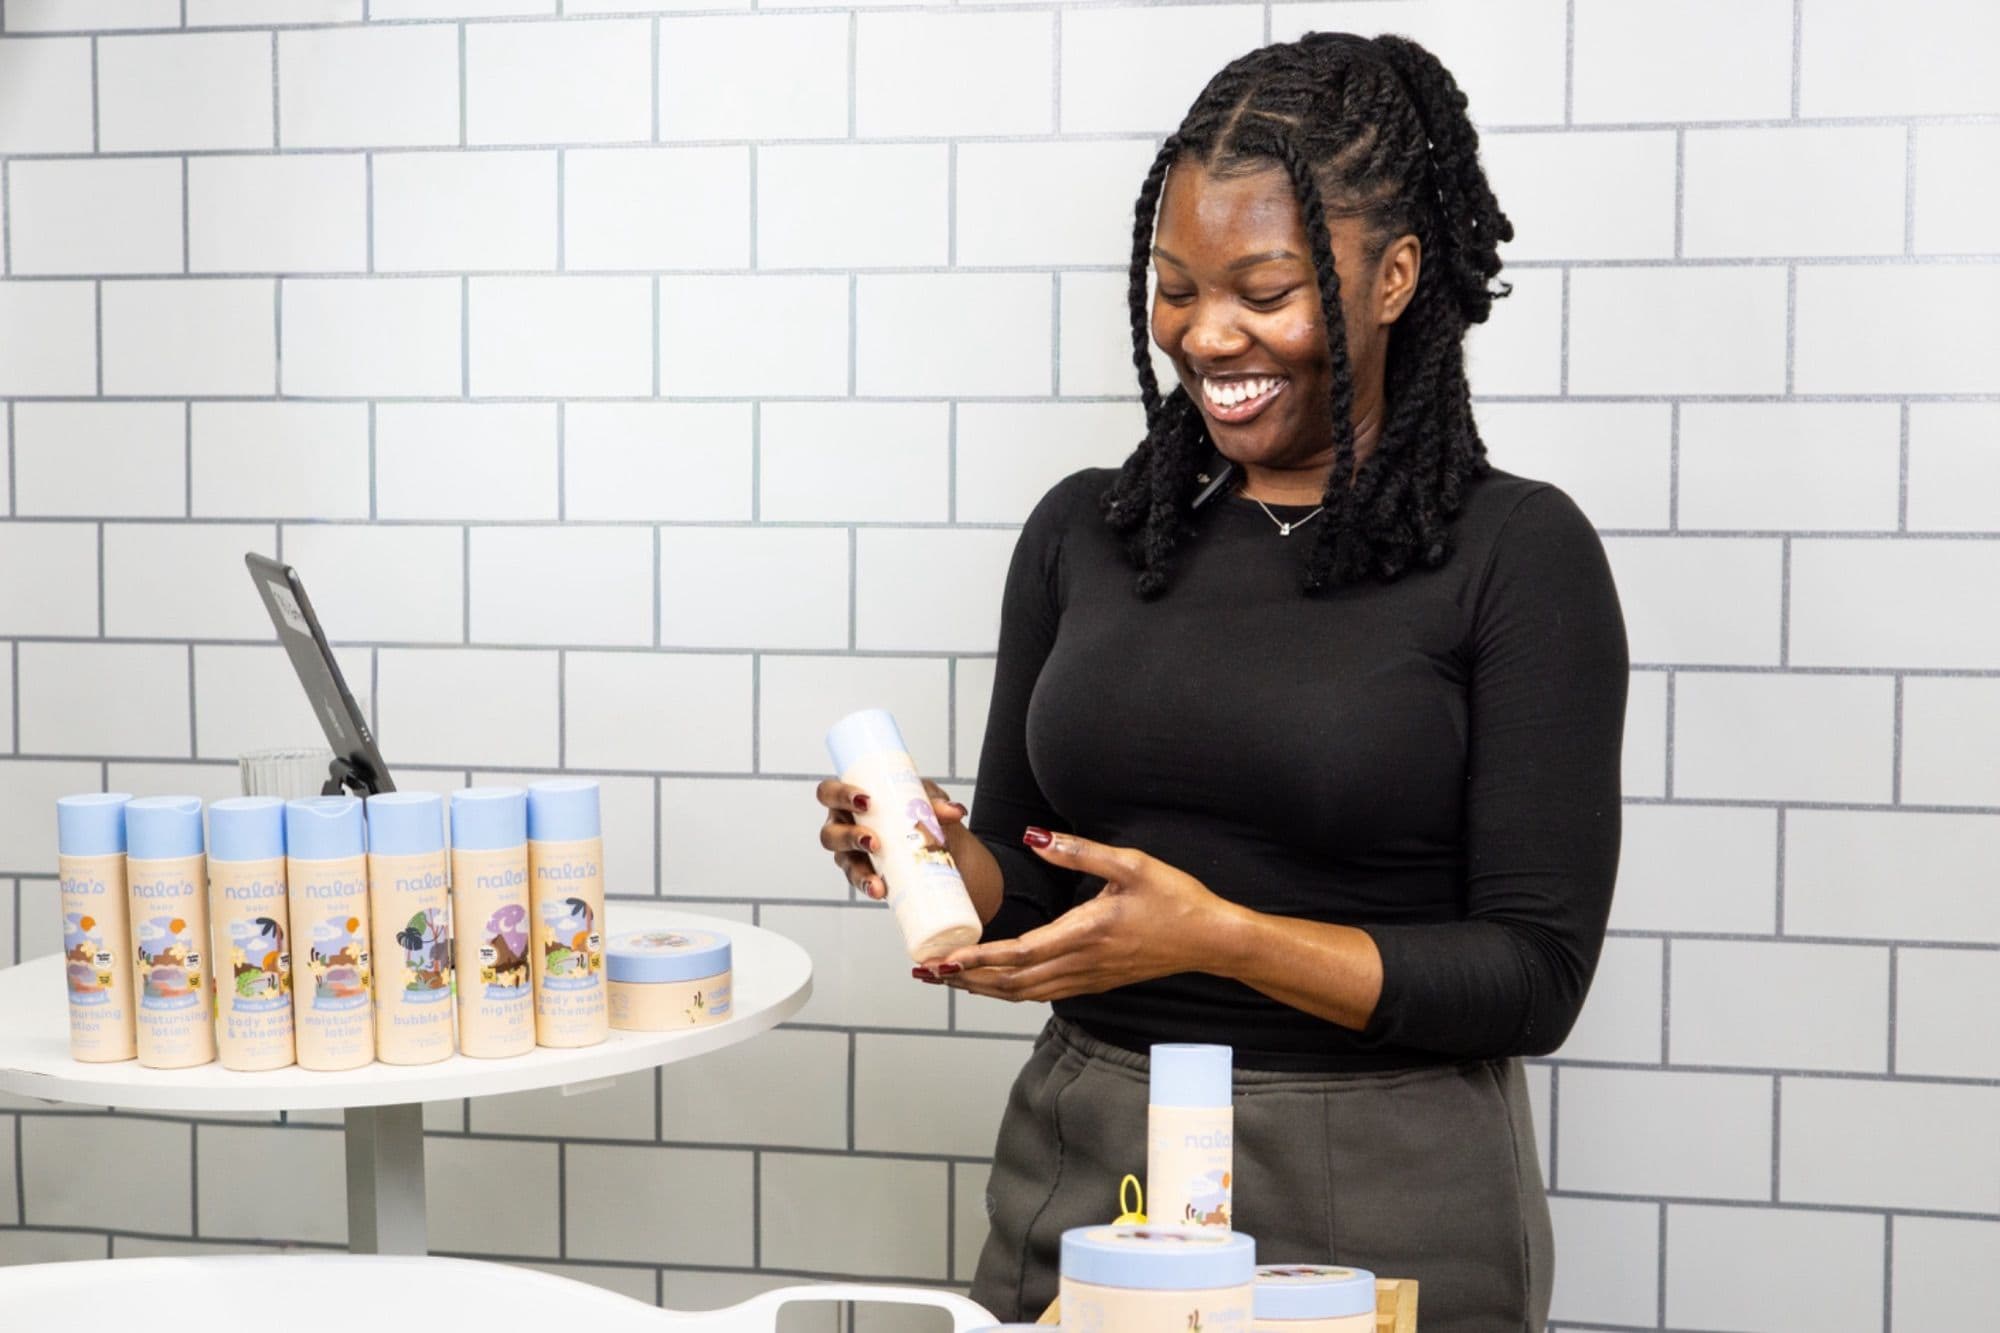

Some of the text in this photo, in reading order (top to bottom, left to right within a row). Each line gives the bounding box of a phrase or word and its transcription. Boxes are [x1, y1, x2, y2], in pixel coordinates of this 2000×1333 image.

[476, 869, 528, 889] nala'
[537, 863, 597, 880] nala's
[61, 877, 106, 895] ala's
[133, 880, 193, 898] nala's
[228, 1013, 290, 1028] body was
[393, 1012, 439, 1026] bubble
[152, 1026, 190, 1037] lotion
[242, 1025, 293, 1039] shampo
